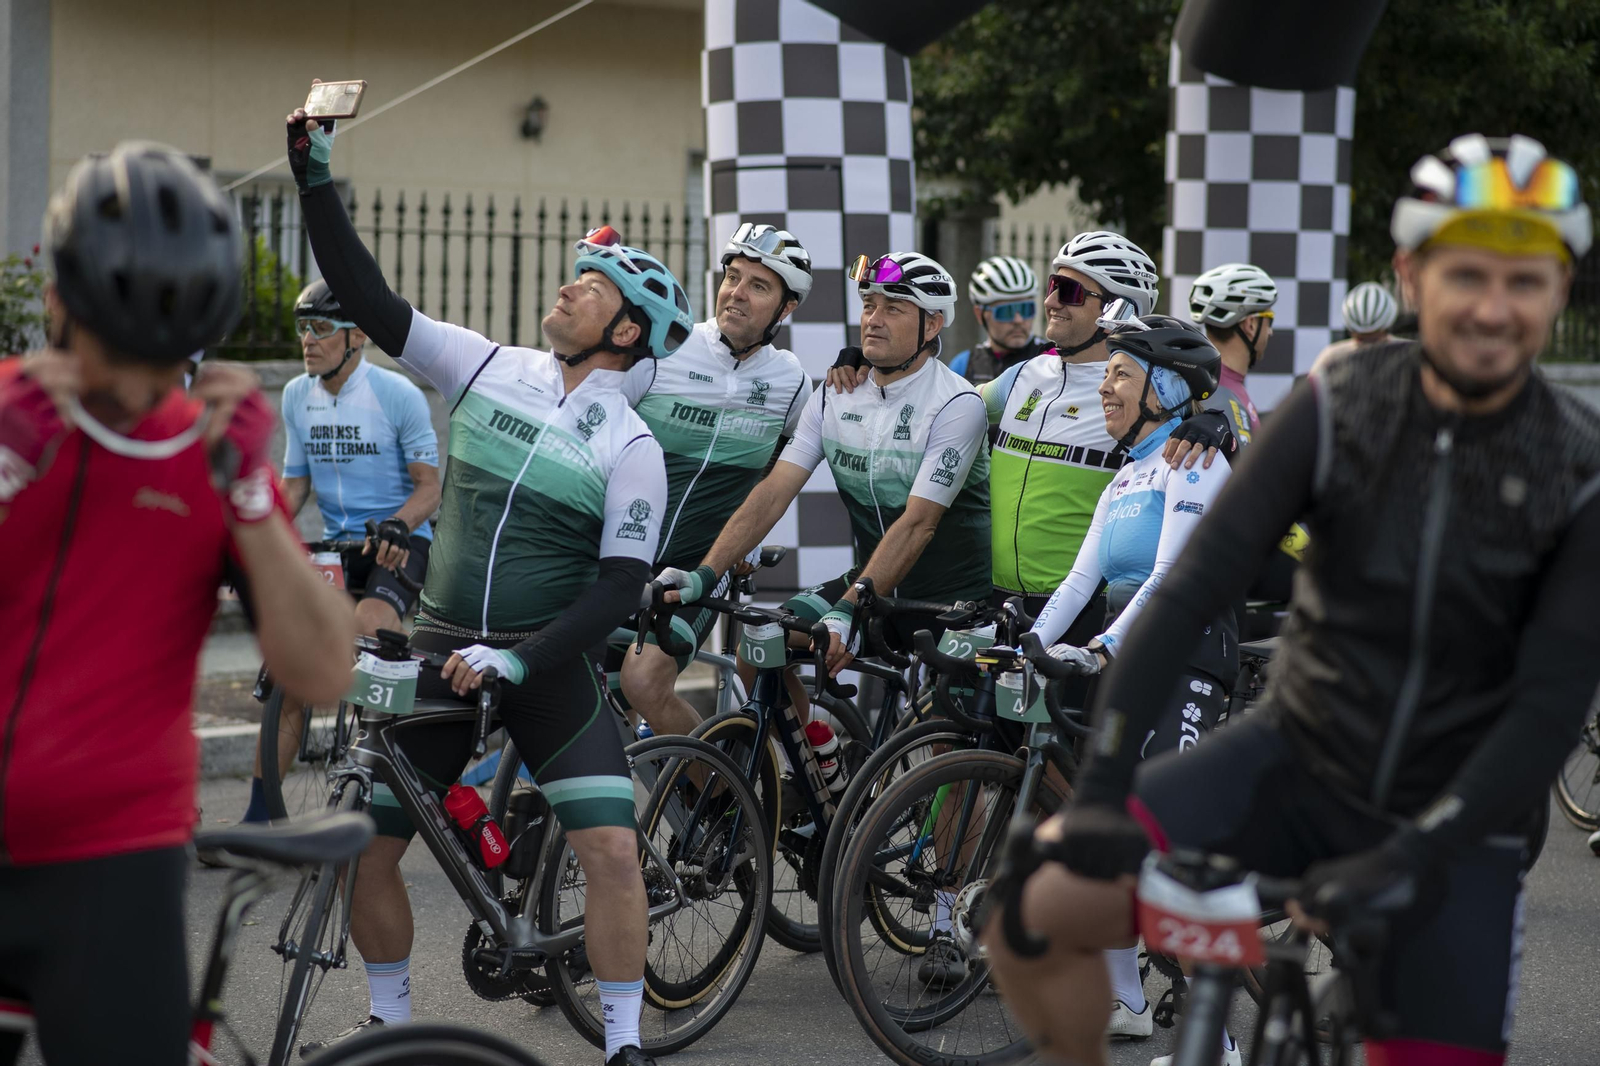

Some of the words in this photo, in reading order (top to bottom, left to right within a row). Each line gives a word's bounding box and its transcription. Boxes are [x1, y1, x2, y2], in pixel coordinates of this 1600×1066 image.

[670, 401, 718, 428] TOTAL
[488, 408, 541, 446] TOTAL
[721, 415, 770, 437] SPORT
[335, 443, 381, 456] TERMAL
[1007, 436, 1034, 453] TOTAL
[1033, 443, 1068, 458] SPORT
[832, 448, 869, 473] TOTAL
[931, 474, 953, 487] SPORT
[934, 467, 956, 480] TOTAL
[617, 529, 647, 541] SPORT
[621, 522, 647, 534] TOTAL
[745, 642, 766, 664] 10
[945, 639, 973, 659] 22
[366, 683, 394, 708] 31
[783, 704, 837, 826] TREK
[393, 742, 508, 932] ORBEA
[1157, 917, 1244, 962] 224
